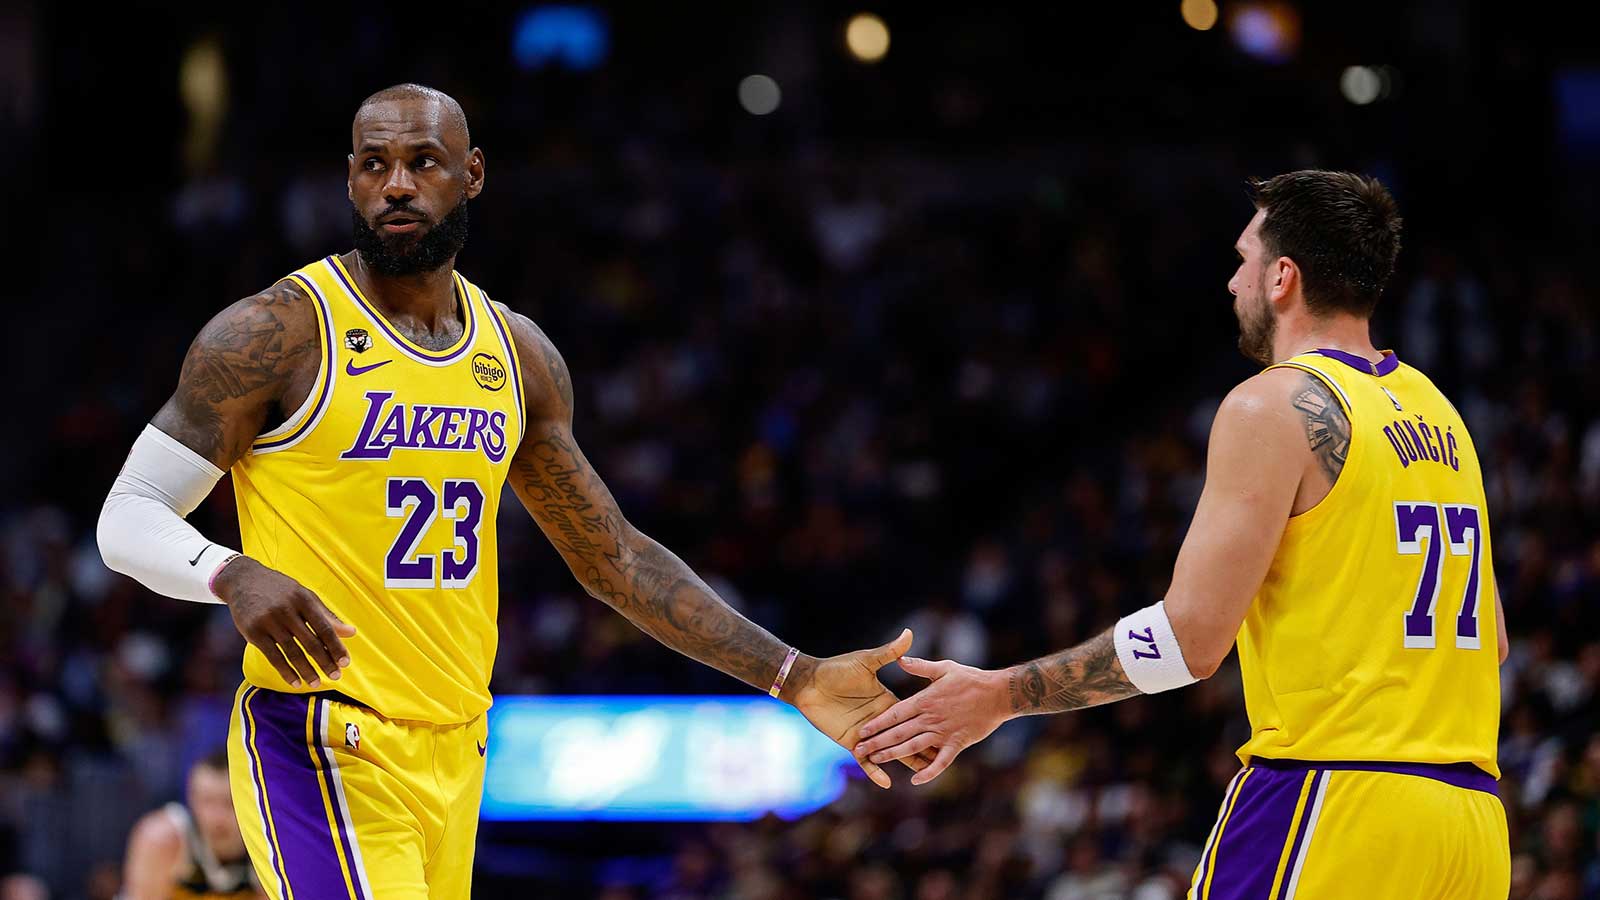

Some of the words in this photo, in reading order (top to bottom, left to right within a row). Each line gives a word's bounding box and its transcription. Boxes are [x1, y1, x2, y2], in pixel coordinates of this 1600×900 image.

[474, 361, 504, 382] bibigo
[338, 390, 508, 464] LAKERS
[384, 477, 486, 589] 23
[1393, 501, 1482, 650] 77
[1128, 626, 1162, 660] 77
